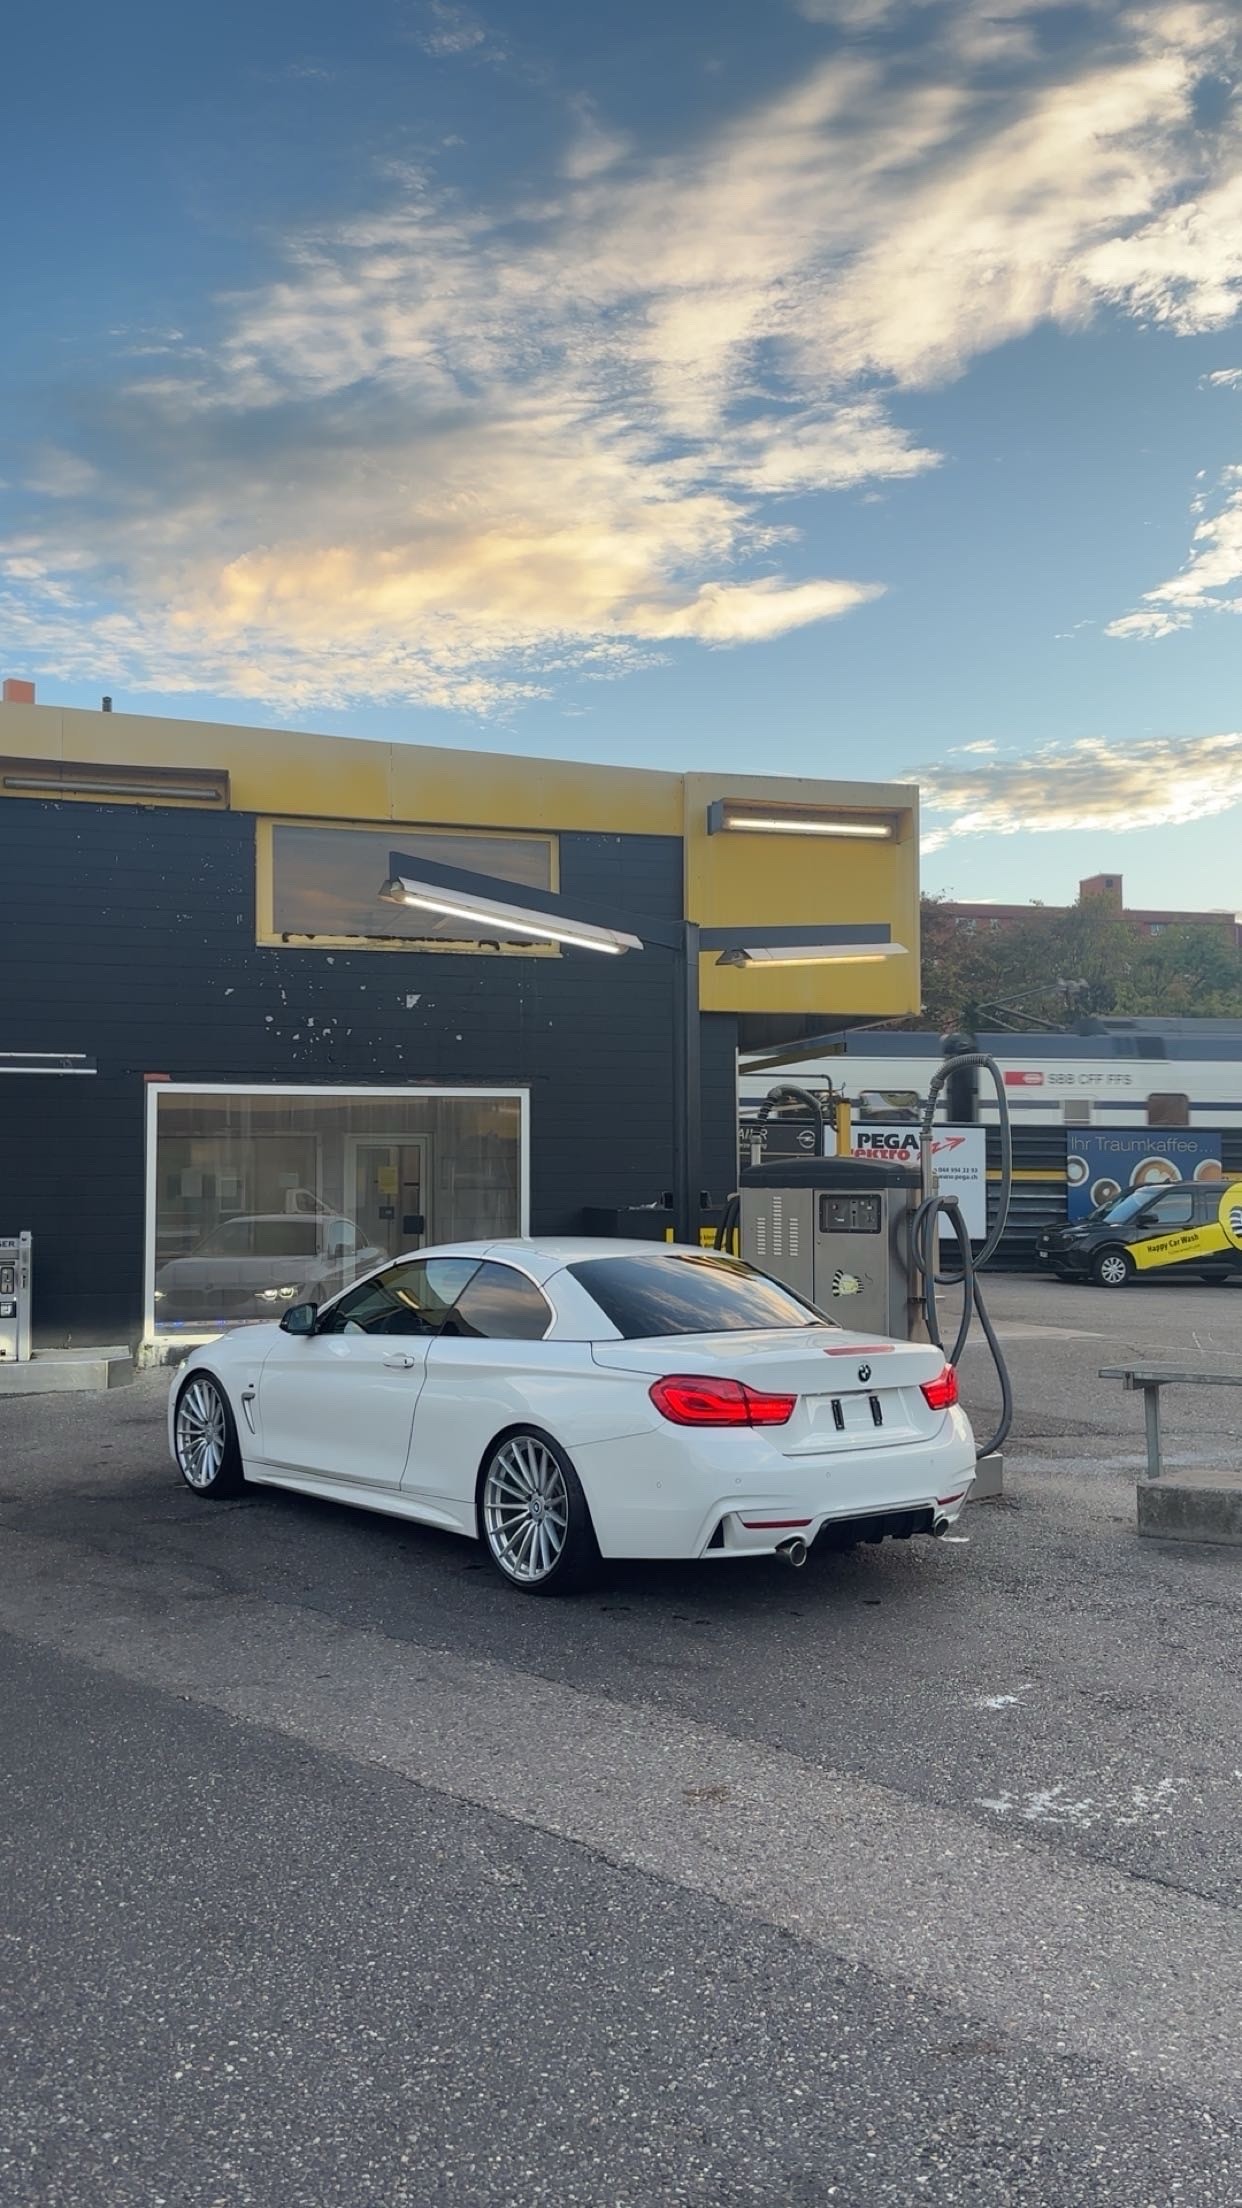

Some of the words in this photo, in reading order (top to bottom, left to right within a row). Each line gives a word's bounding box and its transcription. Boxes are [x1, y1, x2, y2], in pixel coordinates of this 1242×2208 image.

[1048, 1073, 1075, 1085] SBB
[1078, 1073, 1104, 1085] CFF
[1106, 1073, 1133, 1085] FFS
[857, 1133, 920, 1150] PEGA
[1071, 1136, 1090, 1151] Ihr
[0, 1240, 15, 1248] ER
[1147, 1242, 1168, 1253] Happy
[1168, 1239, 1180, 1248] Car
[1180, 1233, 1199, 1244] Wash
